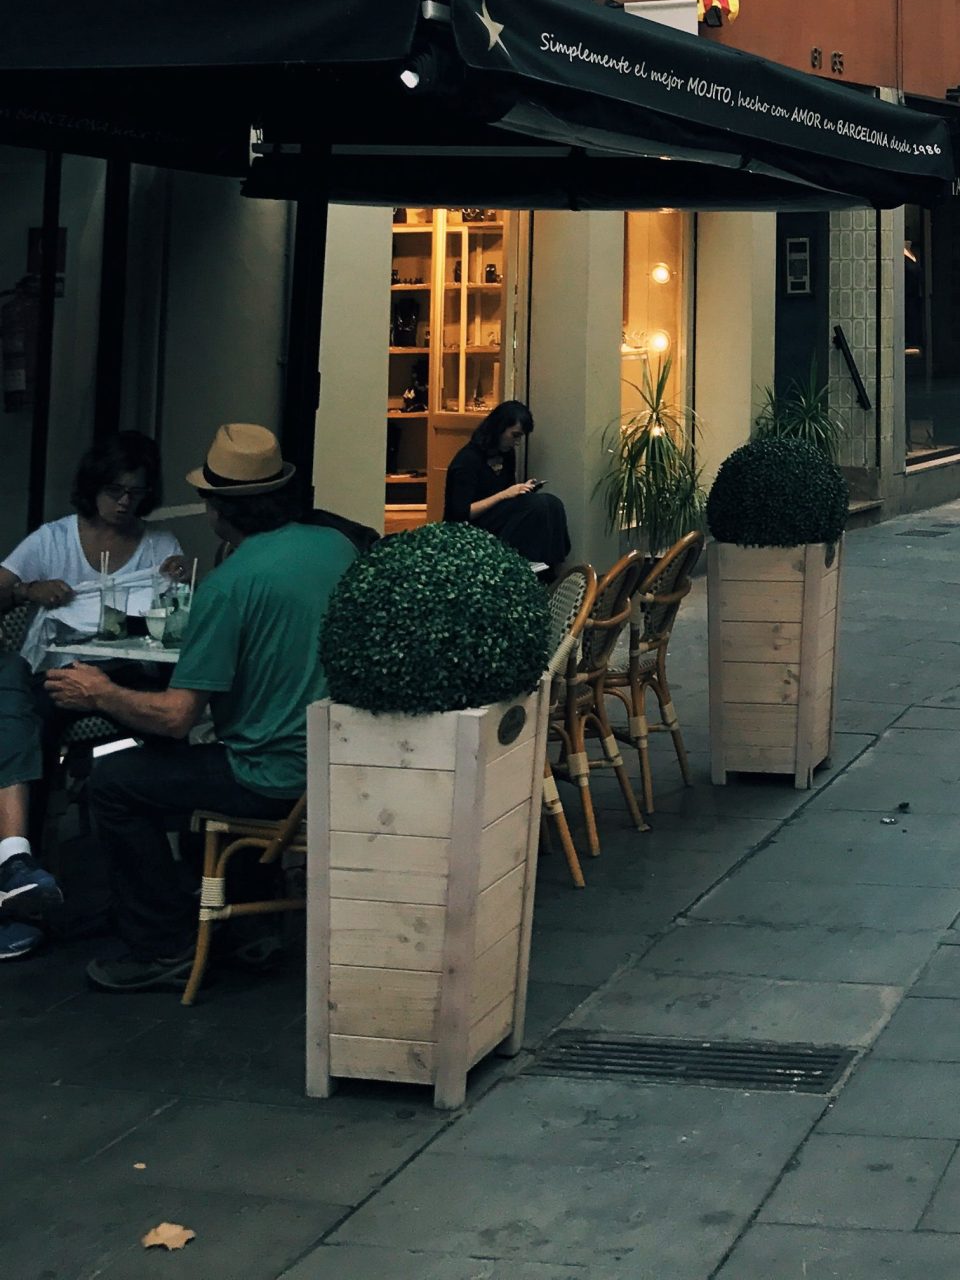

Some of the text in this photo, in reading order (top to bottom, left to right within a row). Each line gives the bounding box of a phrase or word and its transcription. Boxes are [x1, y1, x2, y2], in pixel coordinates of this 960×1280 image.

[539, 32, 941, 156] Simplemente el mejor MOJITO, hecho con AMOR en BARCELONA desde 1986
